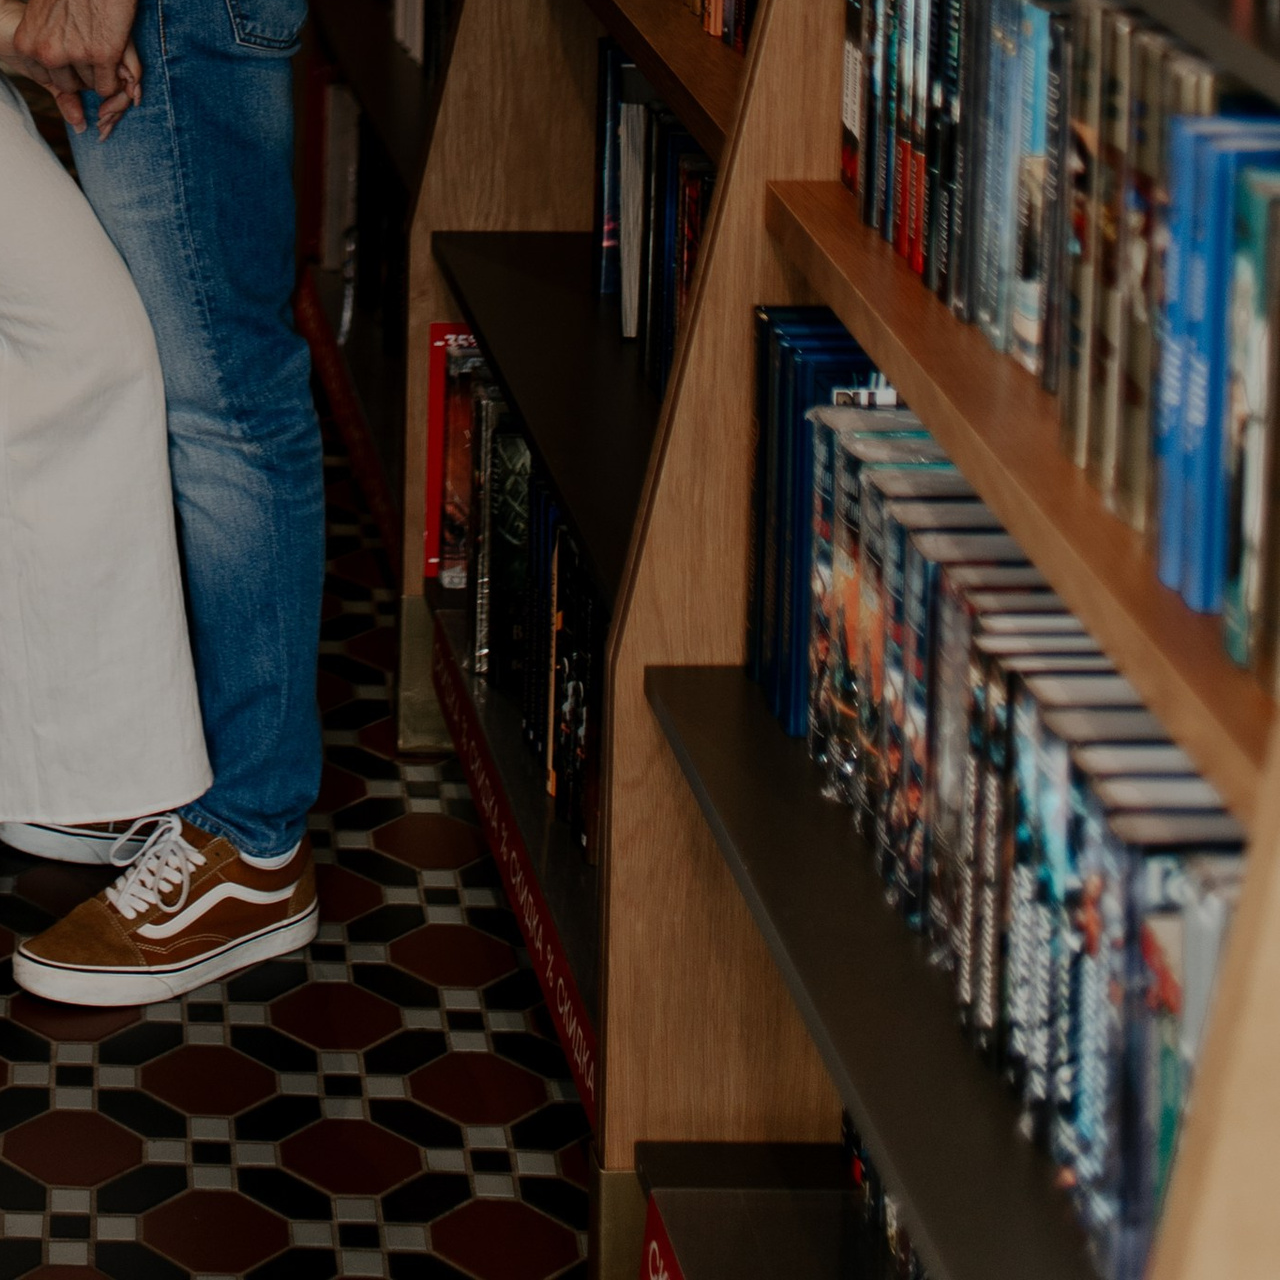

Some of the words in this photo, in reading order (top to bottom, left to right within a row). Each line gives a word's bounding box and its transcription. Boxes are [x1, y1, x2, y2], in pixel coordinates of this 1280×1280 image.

[468, 740, 500, 837] СКИДКА
[509, 849, 544, 960] СКИДКА
[545, 945, 556, 987] %
[556, 976, 595, 1104] СКИДКА
